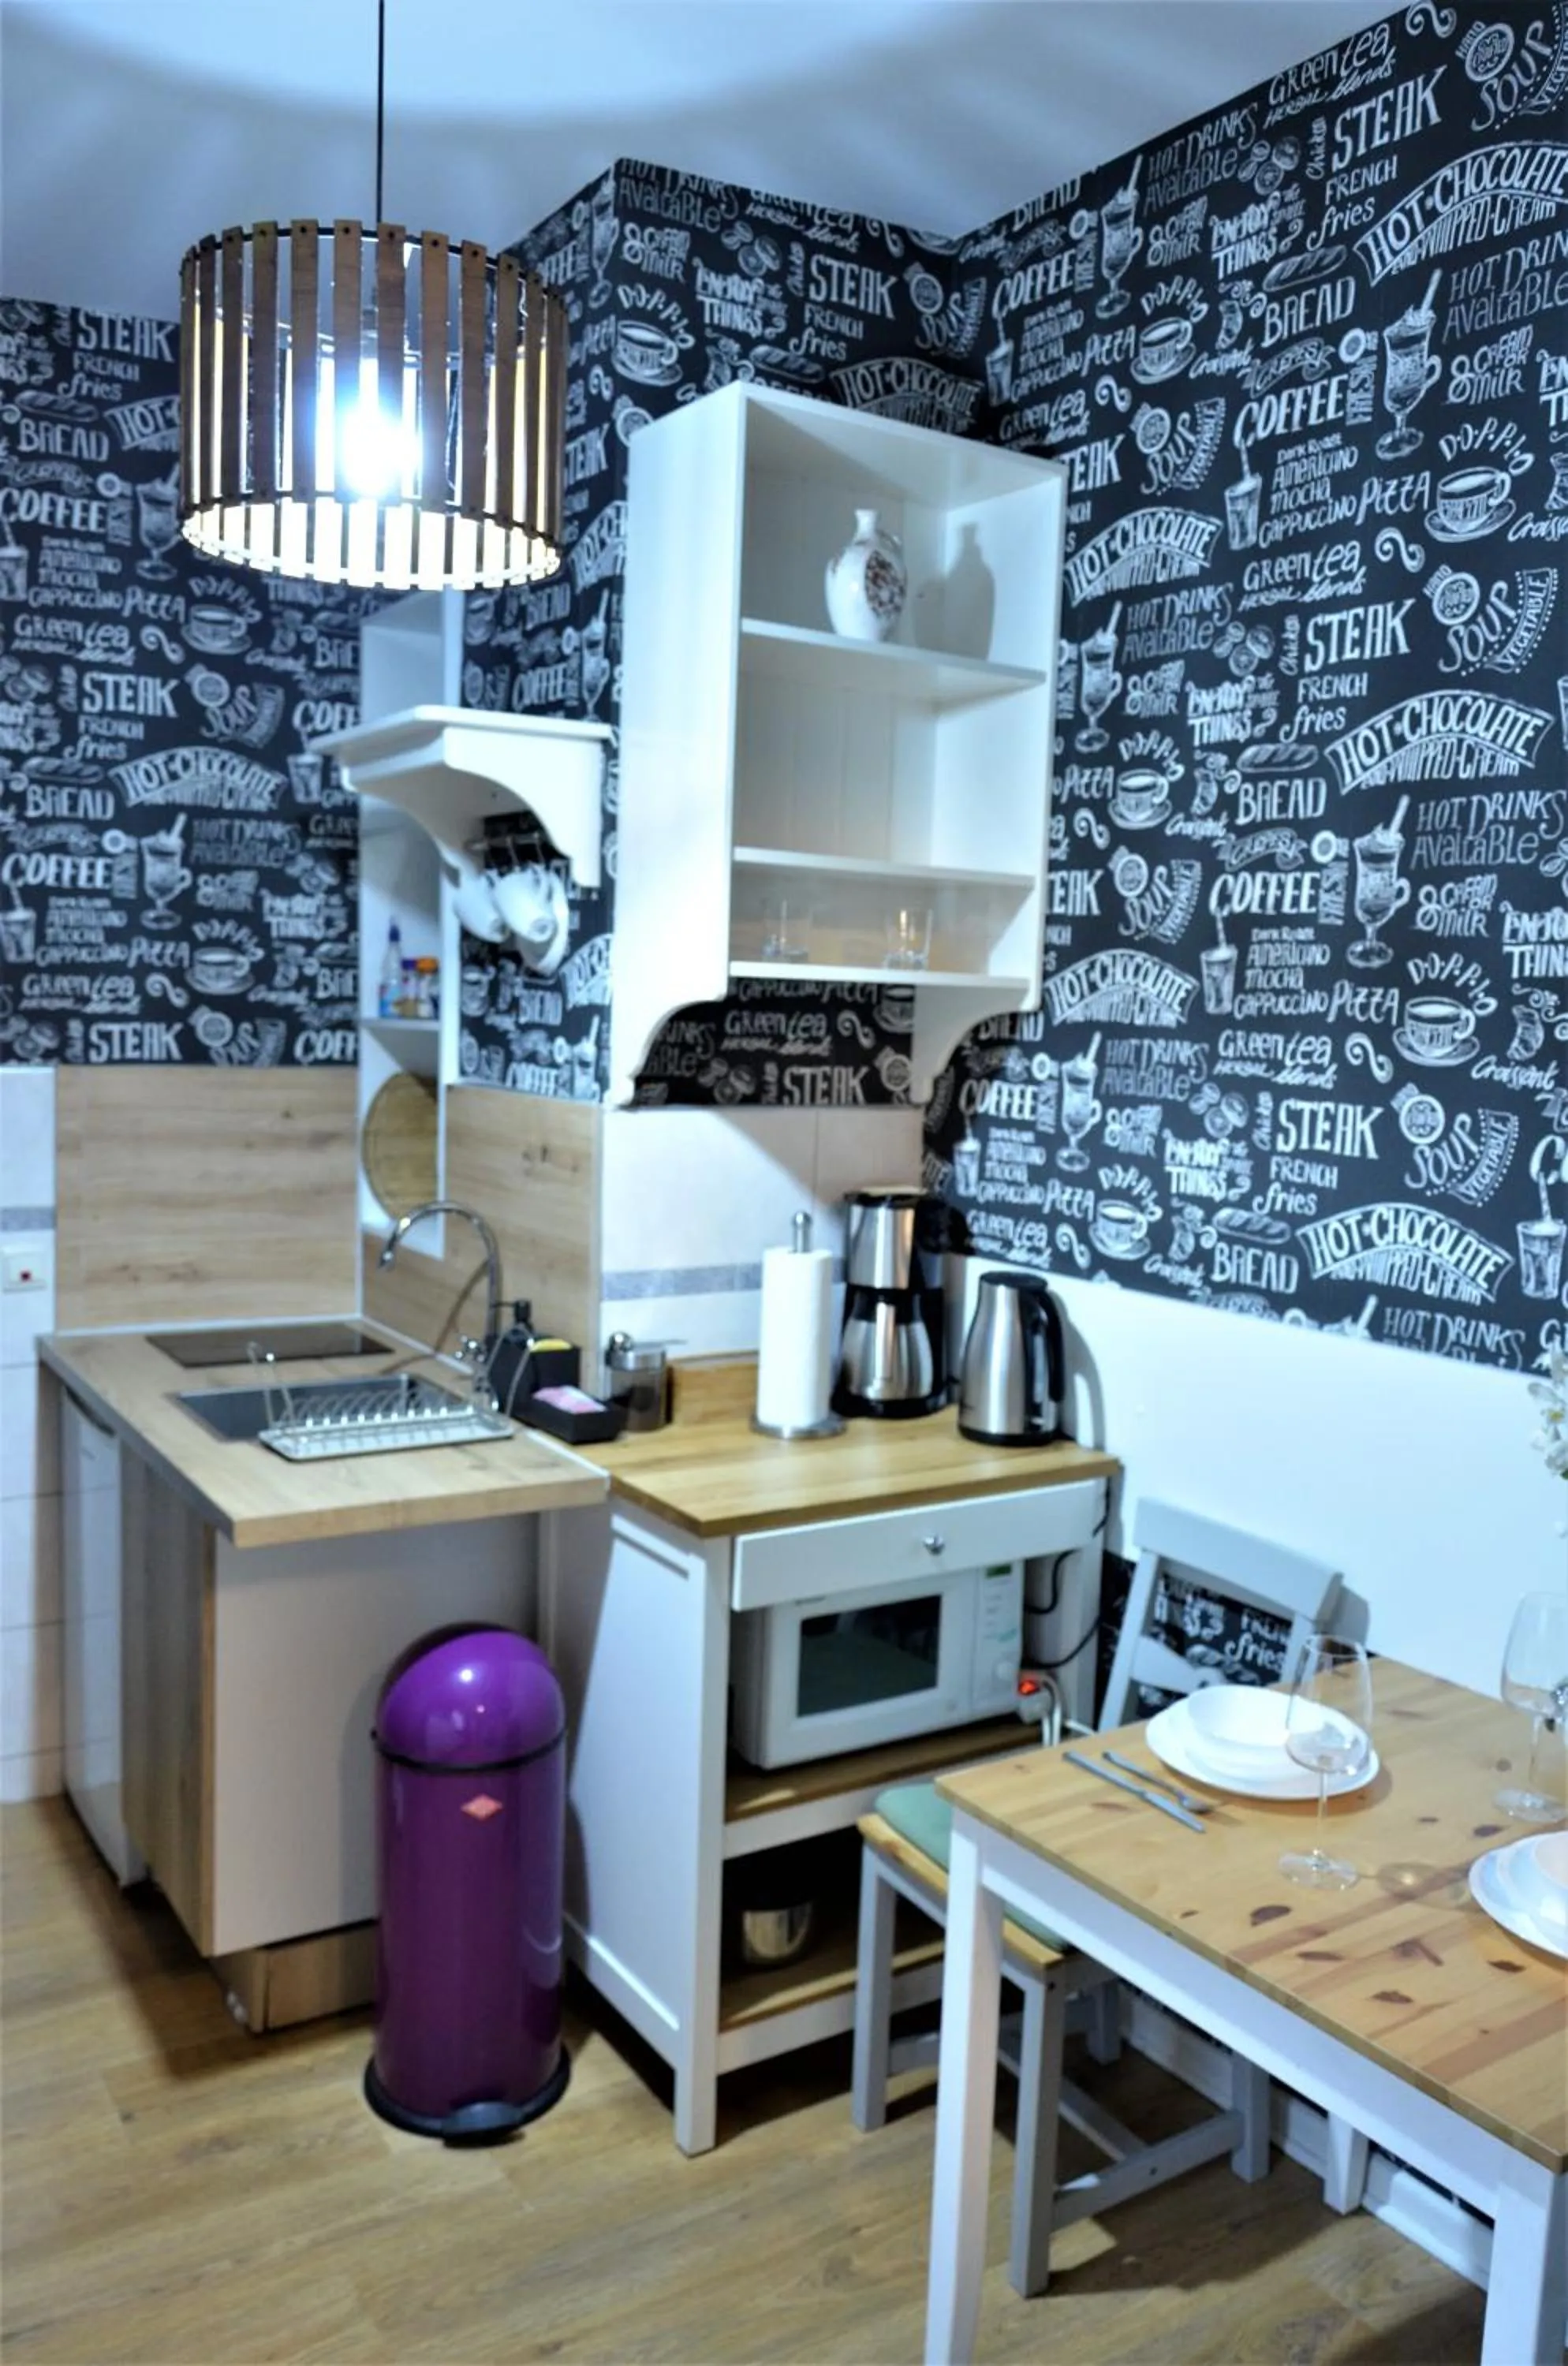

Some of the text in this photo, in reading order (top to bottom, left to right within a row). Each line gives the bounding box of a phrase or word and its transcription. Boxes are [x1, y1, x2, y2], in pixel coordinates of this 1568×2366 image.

[1471, 20, 1552, 132] SOUP
[1331, 64, 1449, 173] STEAK
[1325, 154, 1398, 206] FRENCH
[1211, 226, 1278, 279] THINGS
[809, 254, 898, 319] STEAK
[992, 249, 1077, 319] COFFEE
[1449, 255, 1500, 303] HOT
[79, 313, 175, 363] STEAK
[804, 304, 864, 339] FRENCH
[1261, 278, 1356, 349] BREAD
[73, 353, 140, 382] FRENCH
[1234, 374, 1348, 448] COFFEE
[18, 420, 110, 462] BREAD
[1140, 412, 1197, 494] SOUP
[0, 487, 108, 532] COFFEE
[1116, 513, 1217, 558] CHOCOLATE
[1163, 582, 1234, 631] DRINKS
[1438, 580, 1518, 674] SOUP
[1305, 598, 1417, 672] STEAK
[82, 670, 179, 717] STEAK
[1298, 672, 1368, 703] FRENCH
[1188, 709, 1253, 746] THINGS
[1402, 696, 1545, 756] CHOCOLATE
[25, 785, 114, 820] BREAD
[1235, 778, 1327, 826] BREAD
[1417, 789, 1566, 841] HOT DRINKS
[3, 852, 113, 890] COFFEE
[1209, 871, 1320, 916] COFFEE
[1096, 953, 1194, 1016] CHOCOLATE
[88, 1021, 184, 1063] STEAK
[1141, 1038, 1210, 1084] DRINKS
[783, 1066, 868, 1106] STEAK
[959, 1079, 1036, 1121] COFFEE
[1276, 1097, 1384, 1159] STEAK
[1405, 1113, 1477, 1189] SOUP
[1270, 1155, 1338, 1189] FRENCH
[1211, 1241, 1299, 1295] BREAD
[1370, 1206, 1504, 1289] CHOCOLATE
[1383, 1307, 1432, 1339] HOT
